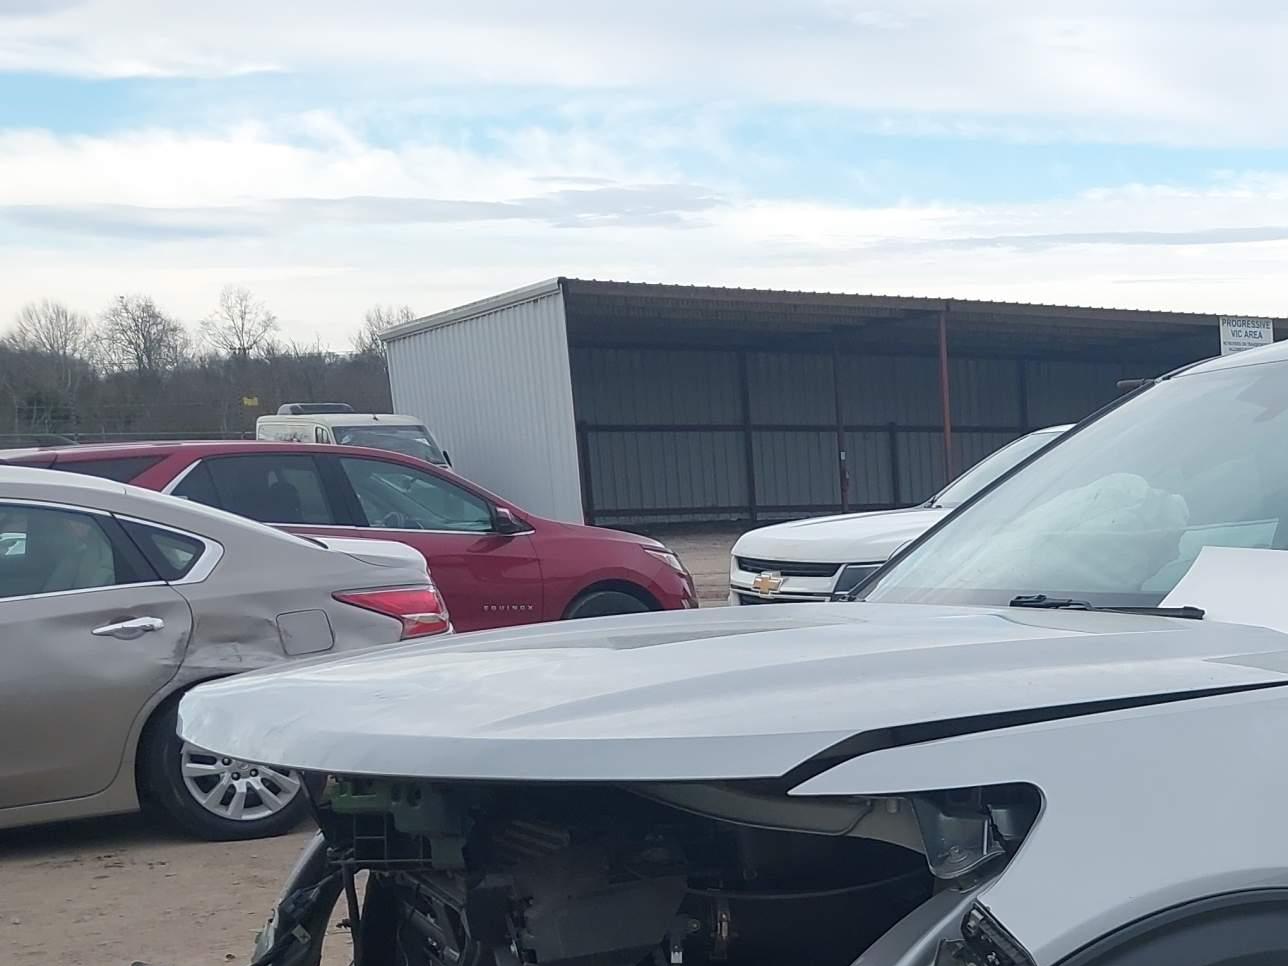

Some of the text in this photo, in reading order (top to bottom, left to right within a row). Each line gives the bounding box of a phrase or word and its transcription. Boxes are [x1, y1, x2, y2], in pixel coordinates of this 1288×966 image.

[1222, 319, 1271, 329] PROGRESSIVE
[1231, 330, 1263, 339] VIC AREA
